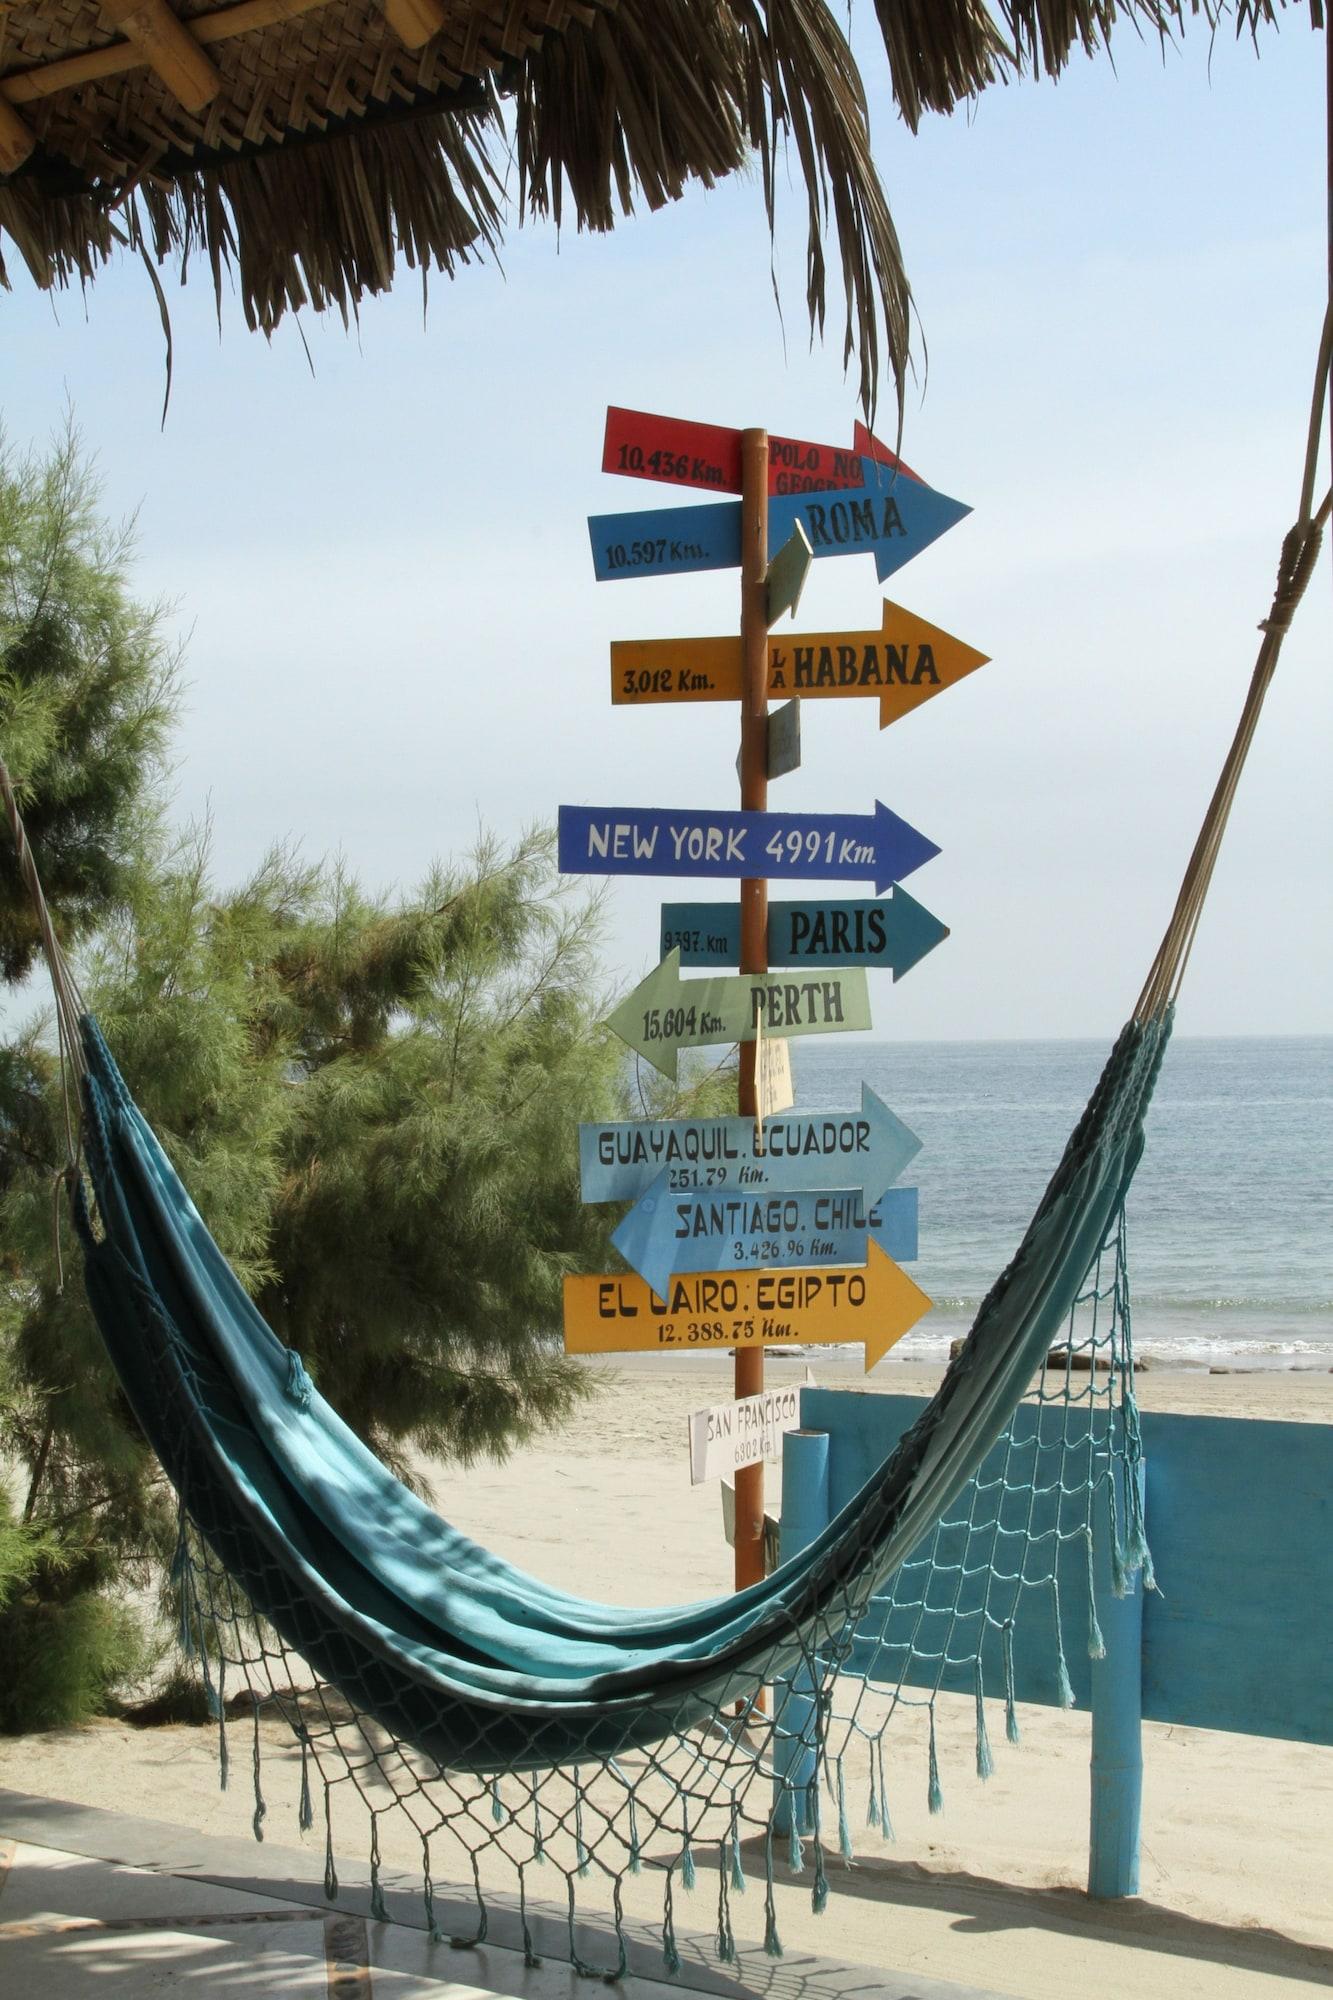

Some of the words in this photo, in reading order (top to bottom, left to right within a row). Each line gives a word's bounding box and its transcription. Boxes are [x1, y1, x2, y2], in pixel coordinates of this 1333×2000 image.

[617, 443, 690, 480] 10.436
[769, 440, 820, 471] POLO
[832, 451, 864, 480] NO
[805, 496, 909, 547] ROMA
[606, 539, 667, 570] 10.597
[677, 668, 716, 692] Km.
[793, 643, 942, 688] HABANA
[587, 823, 659, 860] NEW
[669, 826, 748, 862] YORK
[765, 829, 837, 864] 4991
[788, 908, 887, 955] PARIS
[643, 1005, 698, 1042] 15,604
[700, 1010, 727, 1036] Km.
[750, 981, 845, 1030] PERTH
[752, 1120, 871, 1158] ECUADOR
[599, 1282, 639, 1318] EL
[757, 1274, 867, 1311] EGIPTO
[707, 1408, 733, 1442] SAN
[737, 1392, 796, 1433] FRANCISCO
